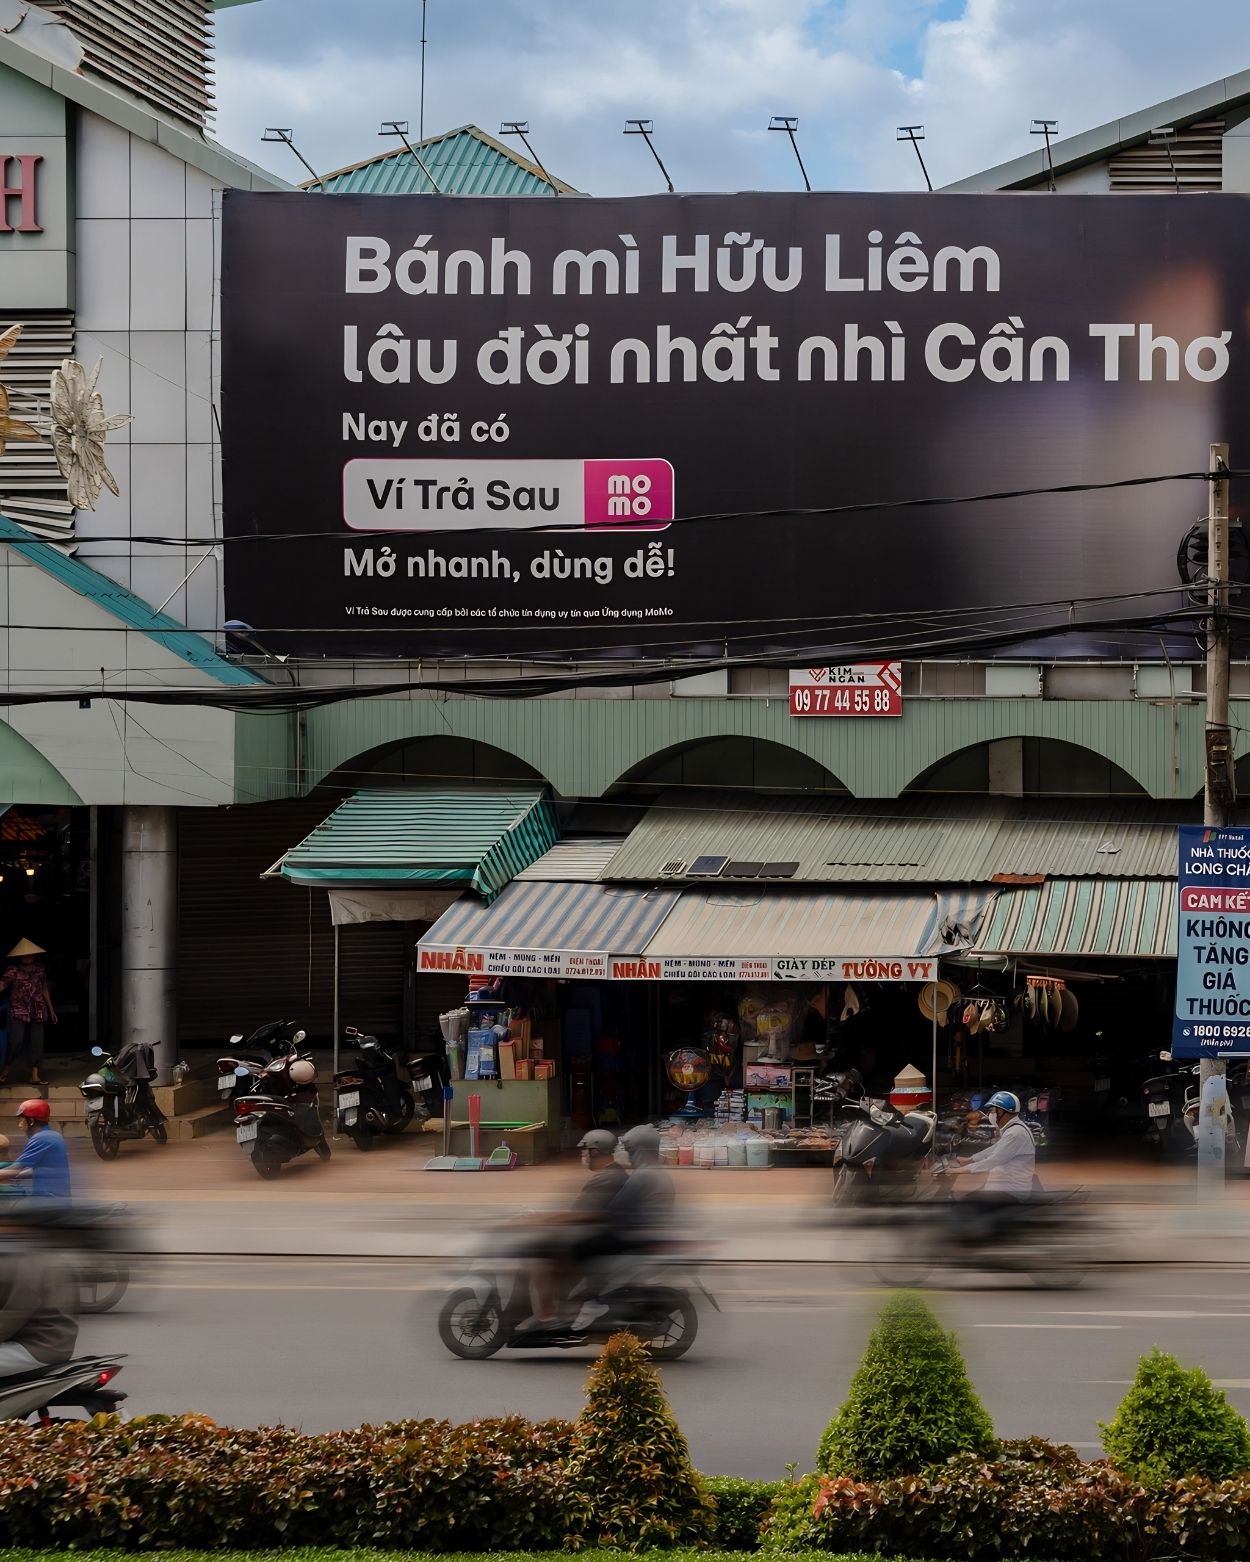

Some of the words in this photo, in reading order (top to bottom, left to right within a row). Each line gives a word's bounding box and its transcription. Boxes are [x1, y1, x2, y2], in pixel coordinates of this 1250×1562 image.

[345, 234, 531, 295] Bánh
[552, 233, 640, 295] mì
[661, 231, 803, 293] Hữu
[825, 230, 1000, 292] Liêm
[343, 322, 457, 385] lâu
[476, 323, 590, 385] đời
[610, 315, 780, 384] nhất
[797, 320, 905, 382] nhì
[924, 315, 1070, 383] Cần
[1088, 323, 1233, 383] Thơ
[342, 412, 408, 447] Nay
[417, 413, 460, 443] đã
[470, 413, 510, 443] có
[366, 477, 407, 510] Ví
[413, 477, 475, 510] Trả
[485, 479, 560, 511] Sau
[607, 474, 652, 495] mo
[607, 495, 652, 516] mo
[343, 545, 397, 577] Mở
[407, 549, 521, 583] nhanh,
[530, 549, 613, 585] dùng
[623, 541, 675, 578] dễ!
[371, 607, 389, 616] Sau
[390, 607, 412, 618] được
[413, 609, 435, 618] cung
[470, 608, 487, 617] các
[534, 608, 556, 619] dụng
[558, 610, 569, 619] uy
[570, 608, 582, 617] tín
[583, 610, 600, 619] qua
[621, 608, 643, 619] dụng
[645, 607, 674, 617] MoMo
[829, 667, 852, 676] KIM
[795, 689, 811, 711] 09
[815, 689, 831, 711] 77
[834, 689, 850, 711] 44
[854, 689, 870, 711] 55
[874, 689, 890, 711] 88
[1191, 845, 1214, 858] NHÀ
[1185, 861, 1223, 875] LONG
[1187, 893, 1222, 909] CAM
[1193, 942, 1249, 965] TĂNG
[777, 957, 808, 970] GIÀY
[812, 957, 836, 970] DÉP
[906, 962, 933, 979] VY
[1203, 967, 1237, 990] GIÁ
[1193, 1025, 1220, 1037] 1800
